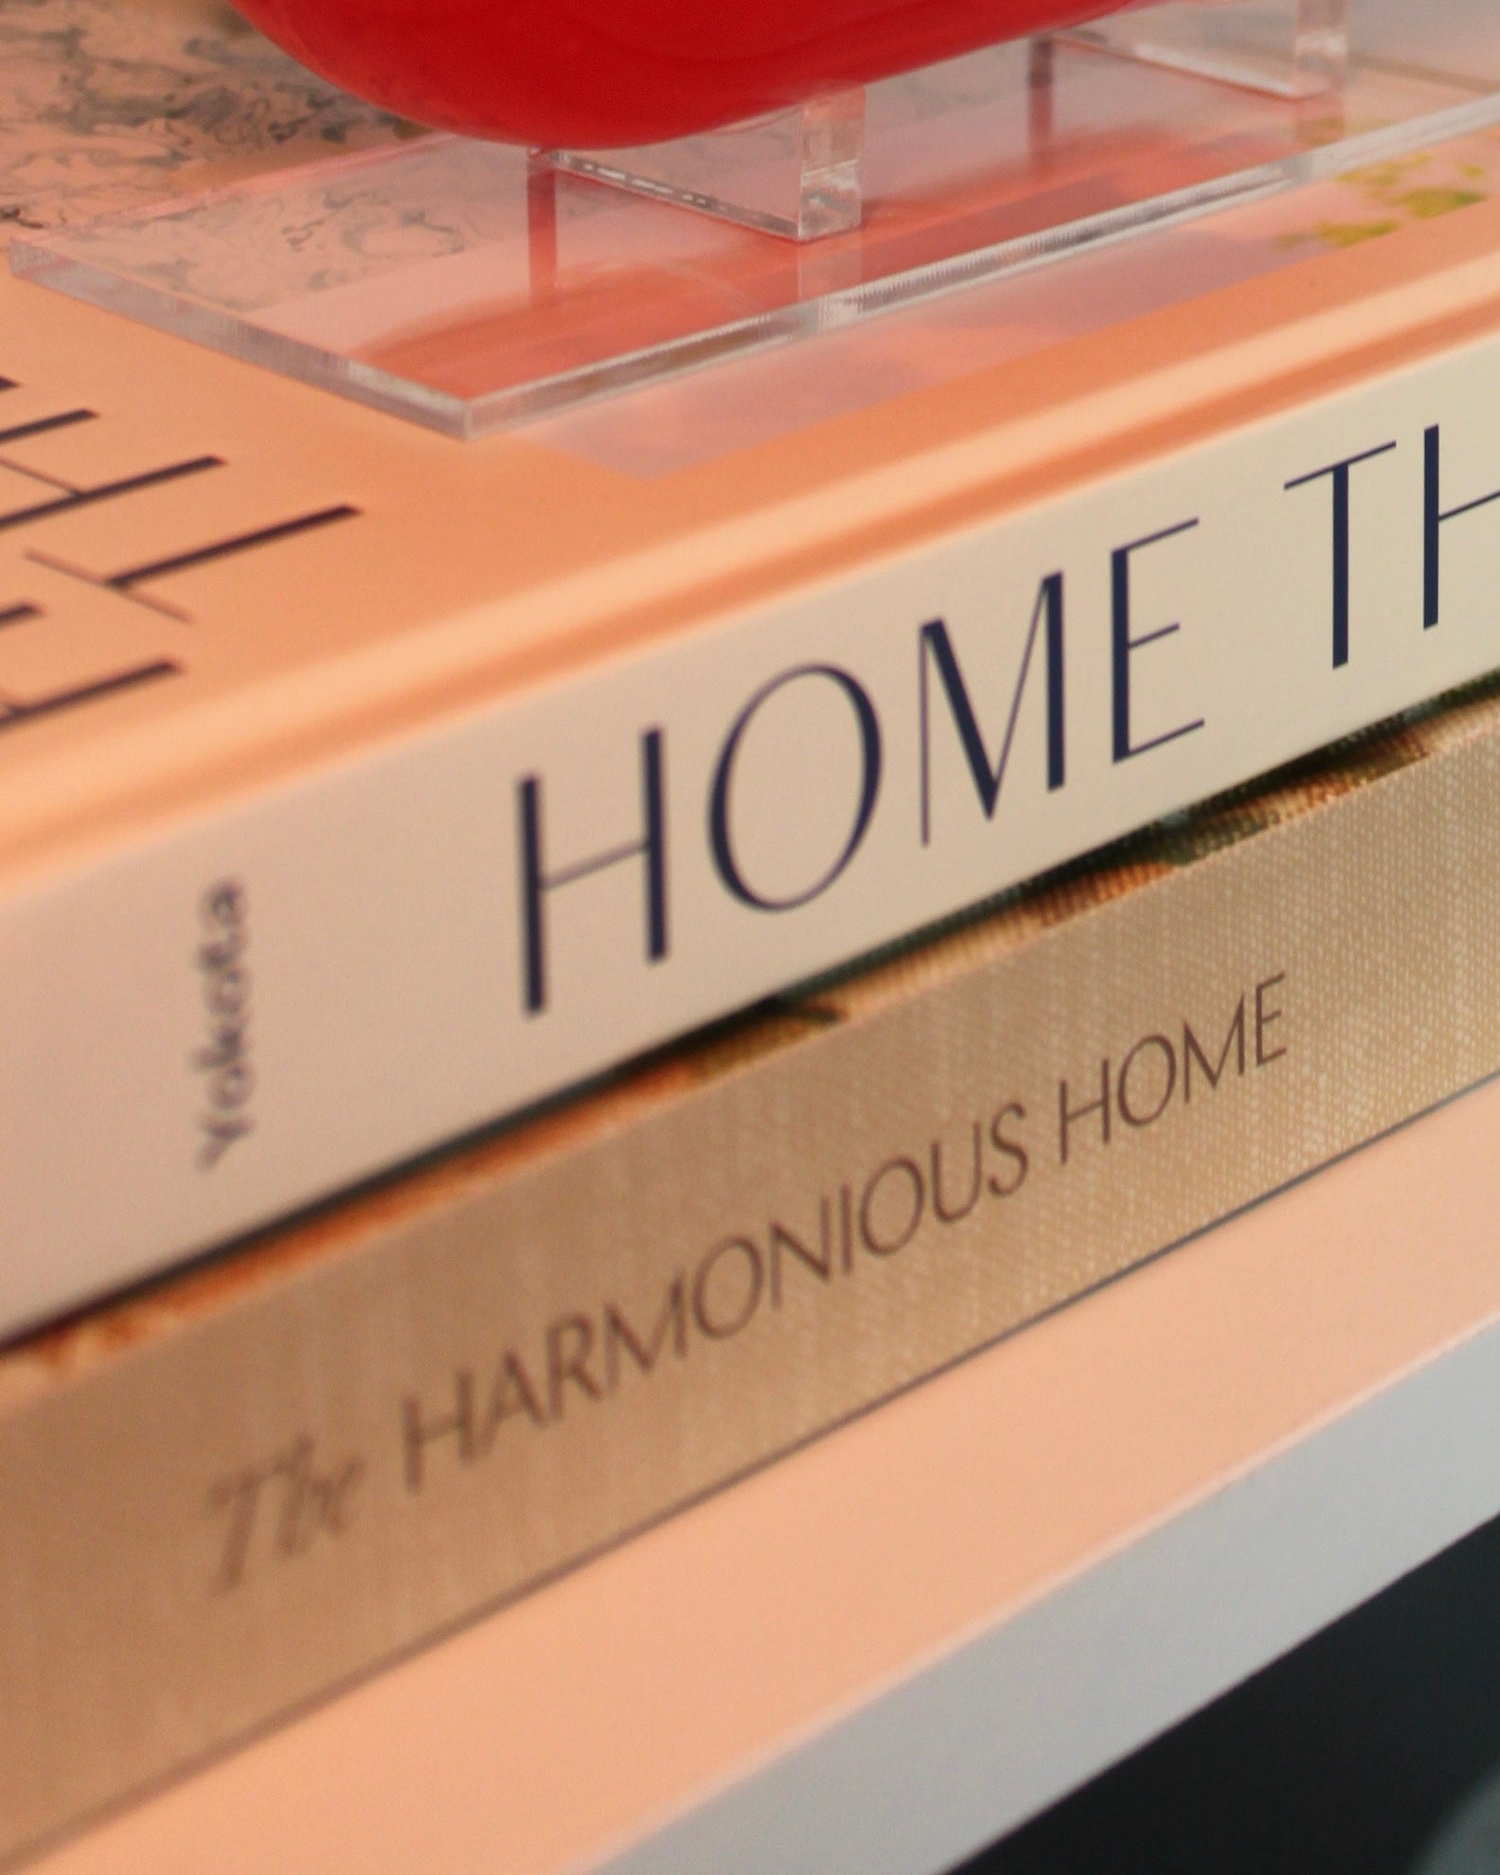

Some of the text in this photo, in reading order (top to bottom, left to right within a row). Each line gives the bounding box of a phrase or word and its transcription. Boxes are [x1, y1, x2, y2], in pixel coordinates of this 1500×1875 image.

[516, 517, 1206, 1018] HOME
[204, 972, 1287, 1596] The HARMONIOUS HOME
